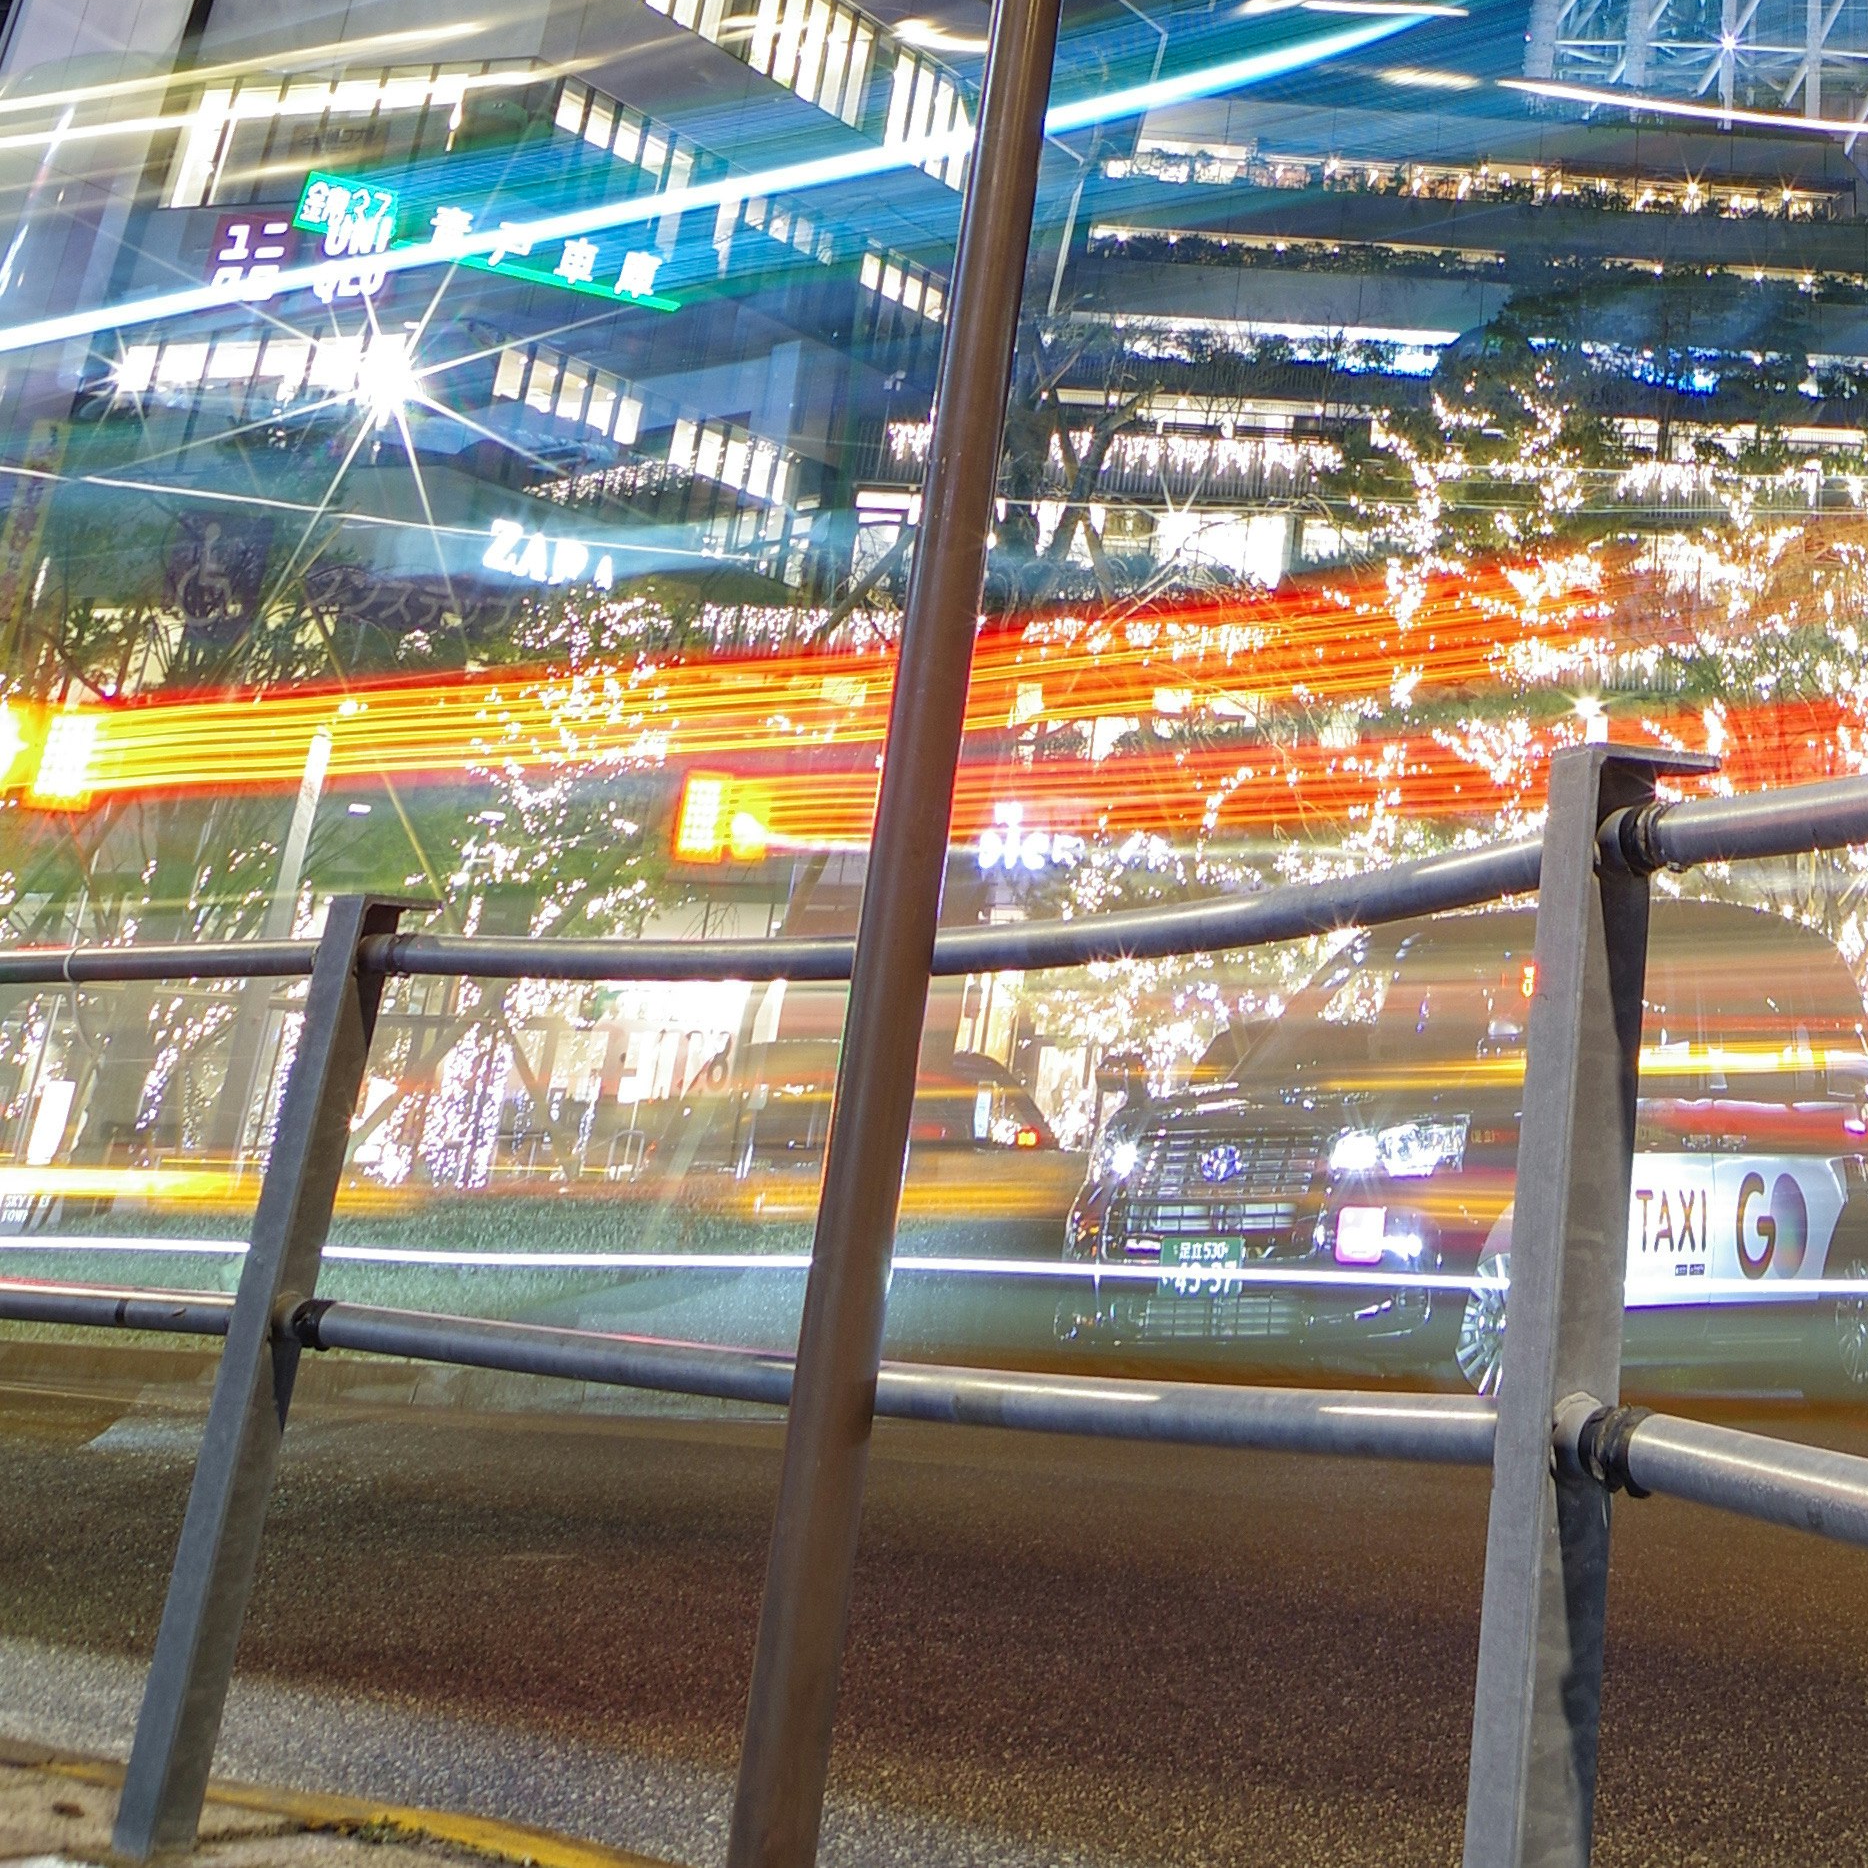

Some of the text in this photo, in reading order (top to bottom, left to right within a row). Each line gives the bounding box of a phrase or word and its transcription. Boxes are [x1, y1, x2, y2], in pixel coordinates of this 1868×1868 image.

[217, 222, 288, 261] ユニ
[1635, 1171, 1808, 1280] TAXI GO
